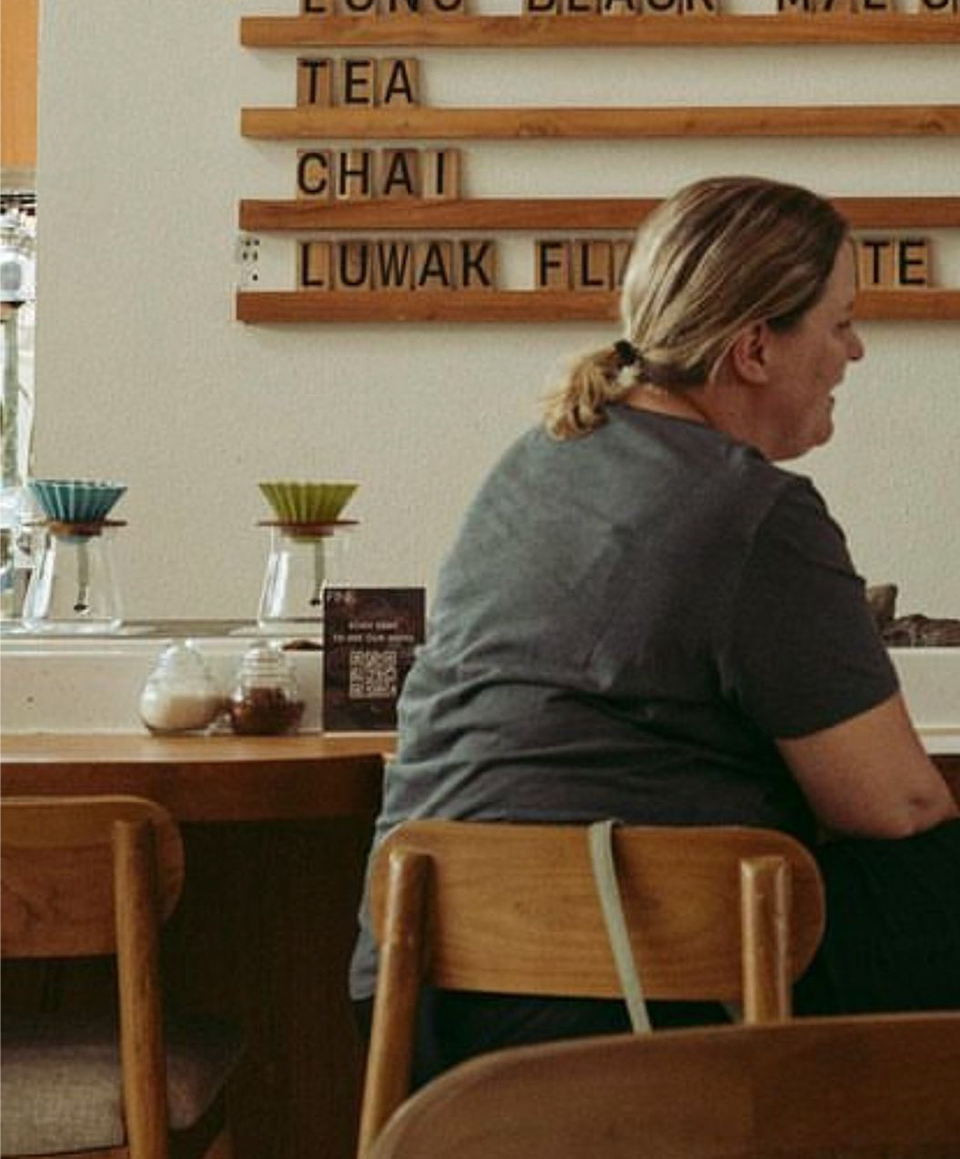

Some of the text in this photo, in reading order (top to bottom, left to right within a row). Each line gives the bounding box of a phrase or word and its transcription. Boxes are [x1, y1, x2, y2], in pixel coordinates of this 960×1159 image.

[301, 60, 415, 104] TEA
[297, 152, 446, 195] CHAI
[300, 243, 491, 288] LUWAK
